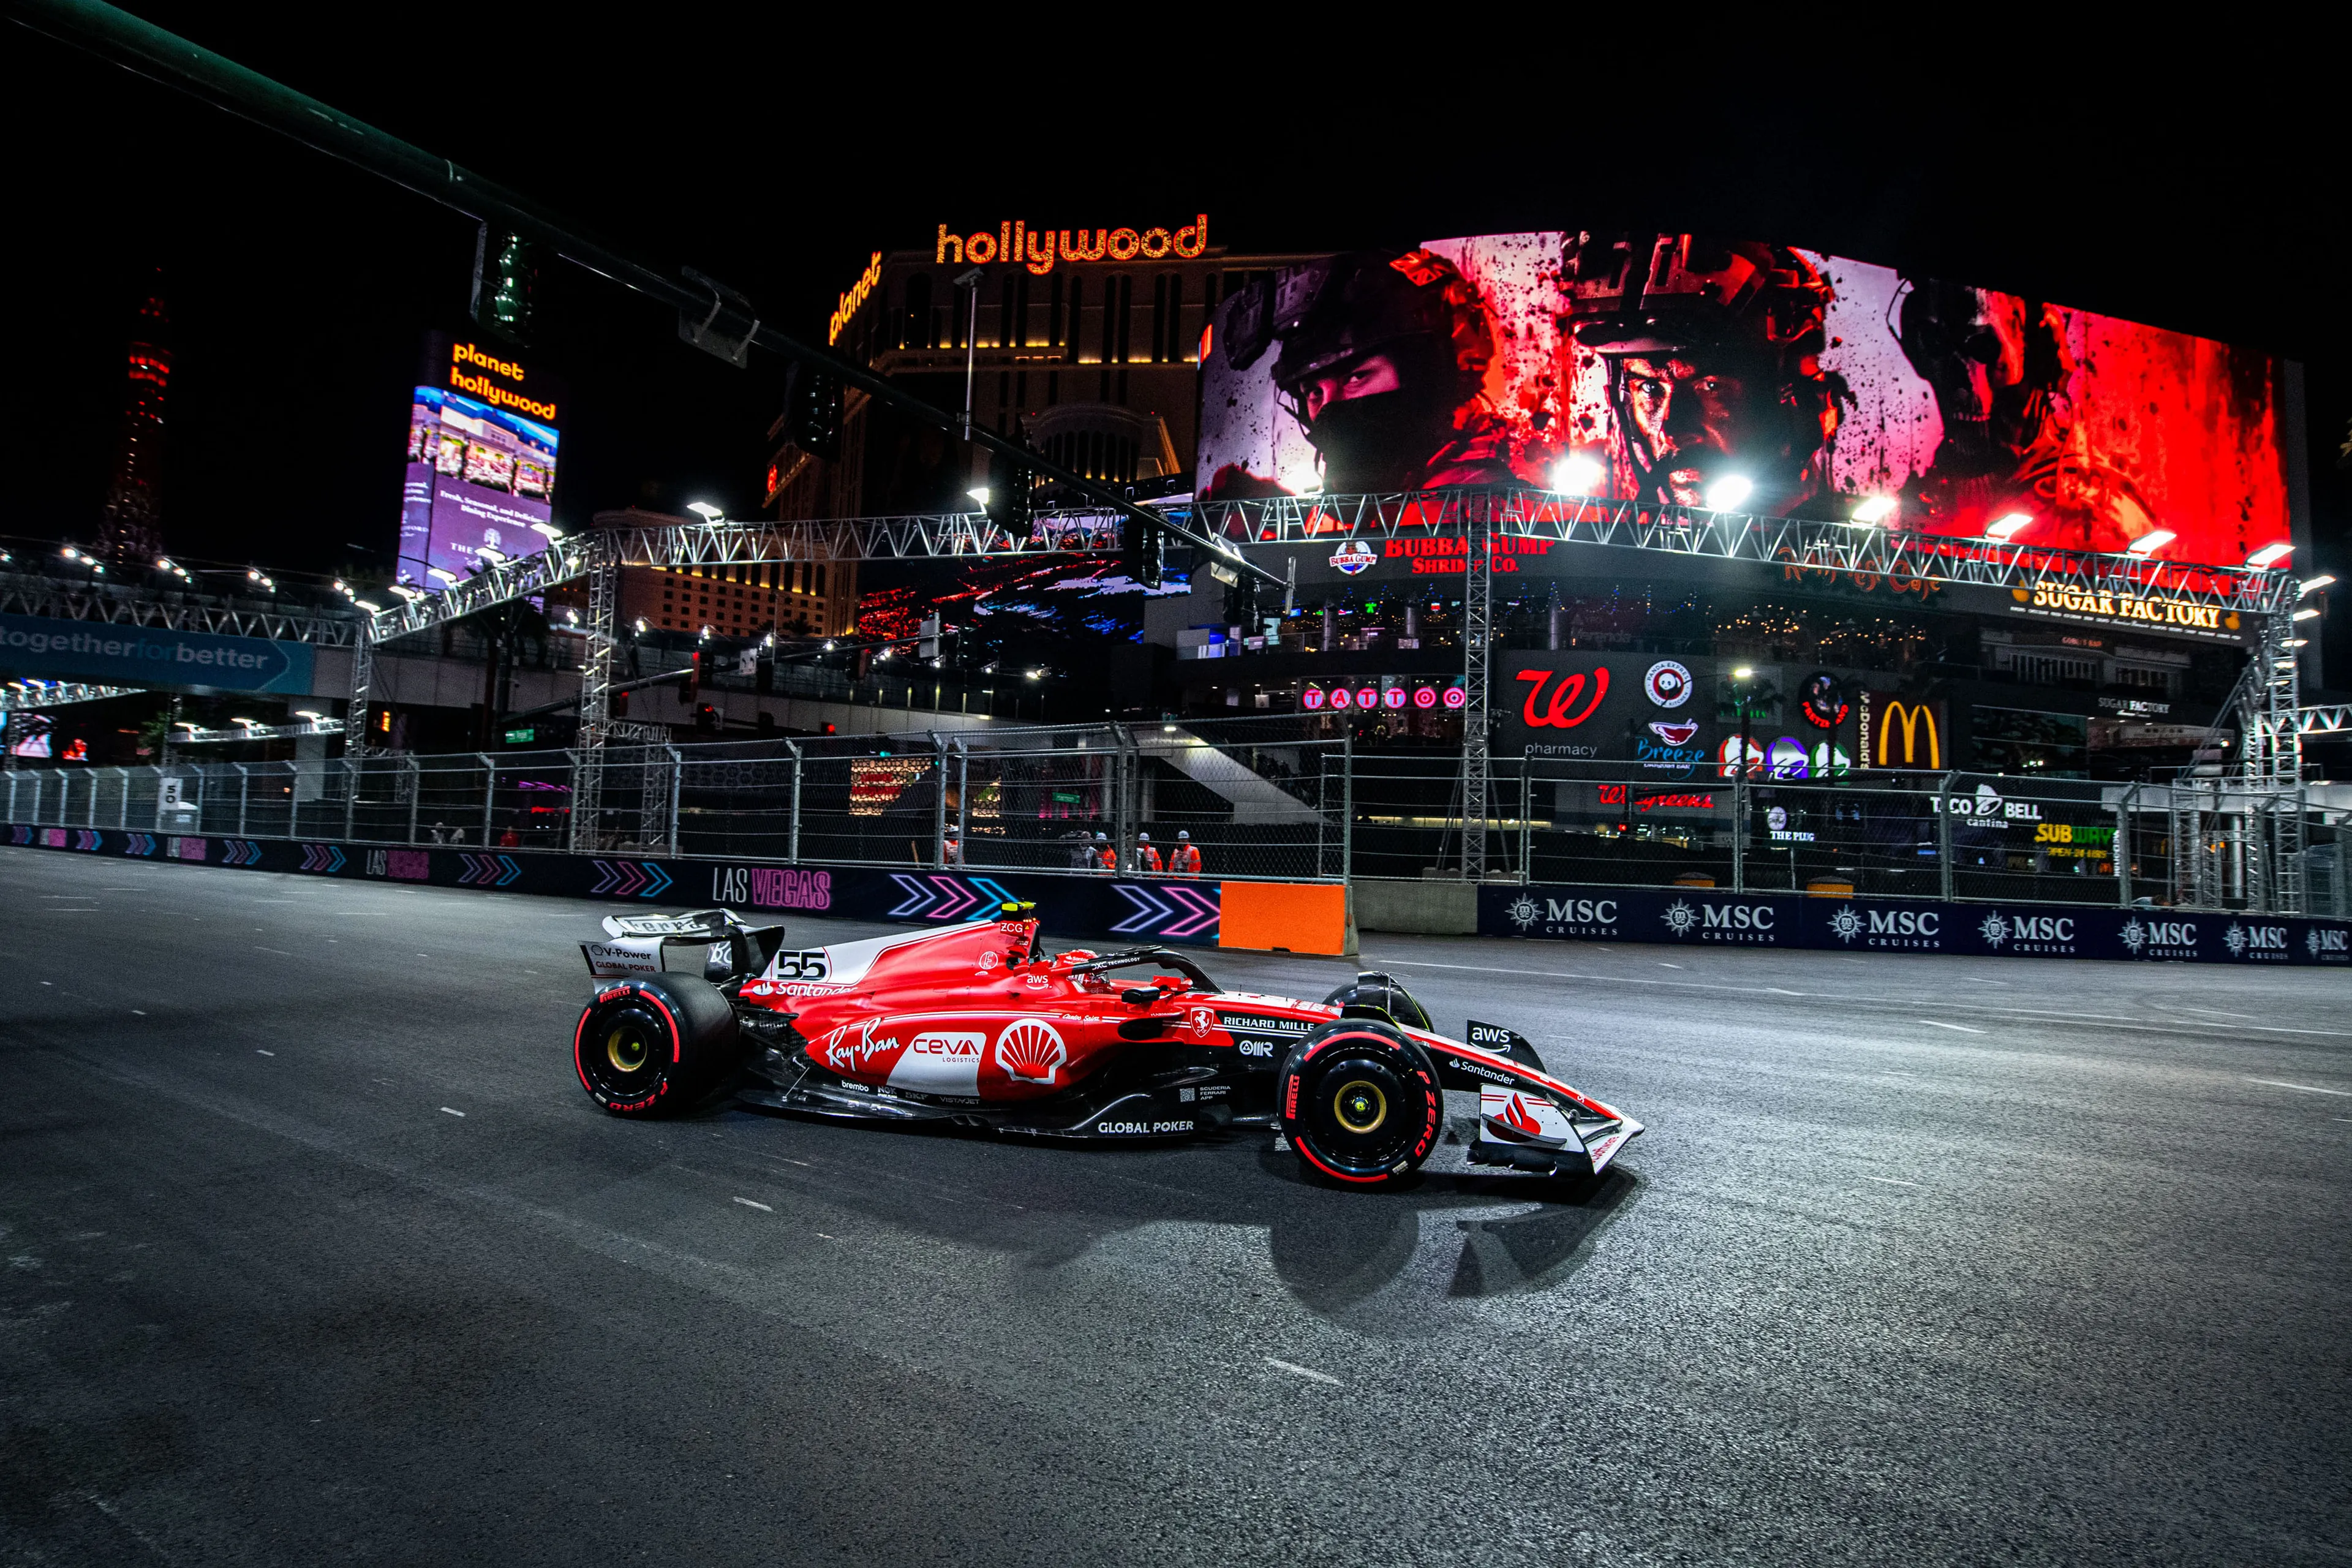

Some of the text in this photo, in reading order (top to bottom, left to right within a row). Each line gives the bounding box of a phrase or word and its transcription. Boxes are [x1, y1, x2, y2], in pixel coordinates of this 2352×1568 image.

[936, 214, 1208, 275] hollywood
[829, 251, 881, 346] planet
[453, 344, 524, 381] planet
[450, 366, 556, 420] hollywood
[499, 507, 514, 516] and
[451, 542, 473, 554] THE
[1384, 535, 1469, 557] BUBBA
[1331, 554, 1376, 565] BUBBA GUMP
[2034, 581, 2116, 615] SUGAR
[2118, 592, 2222, 629] FACTORY
[1648, 663, 1665, 681] PANDA
[1304, 688, 1466, 709] TATTOO
[2098, 697, 2128, 709] SUGAR
[2128, 700, 2171, 714] FACTORY
[1525, 742, 1598, 758] pharmacy
[1635, 736, 1705, 780] Breeze
[1930, 797, 2043, 820] TCO BELL
[1967, 818, 2009, 829] cantina
[1770, 831, 1815, 841] THE PLUG
[2035, 823, 2116, 845] SUBWAY
[366, 850, 386, 875] LAS
[713, 867, 831, 910] LAS VEGAS
[1546, 899, 1617, 924] MSC
[1702, 904, 1774, 930] MSC
[1546, 925, 1618, 935] CRUISES
[1868, 910, 1939, 936] MSC
[2013, 916, 2075, 941] MSC
[1702, 932, 1774, 941] CRUISES
[2148, 922, 2197, 945] MSC
[2248, 926, 2288, 949] MSC
[2320, 930, 2348, 950] MSC
[1868, 938, 1940, 948] CRUISES
[2013, 943, 2076, 953] CRUISES
[603, 948, 652, 960] V-Power
[1108, 957, 1140, 966] TECHNOLOGY
[2149, 949, 2198, 957] CRUISES
[595, 961, 656, 973] GLOBAL POKER
[777, 951, 826, 981] 55
[1027, 974, 1048, 984] aws
[600, 986, 630, 1003] PIRELLI
[776, 982, 858, 997] Santander
[1224, 1017, 1314, 1031] RICHARD MILLE
[1472, 1027, 1510, 1042] aws
[1461, 1061, 1515, 1085] Santander
[842, 1080, 869, 1092] brembo
[905, 1091, 929, 1100] SKF
[1286, 1074, 1300, 1120] PIRELLI
[1415, 1071, 1436, 1157] P ZERO
[1098, 1121, 1194, 1133] GLOBAL POKER
